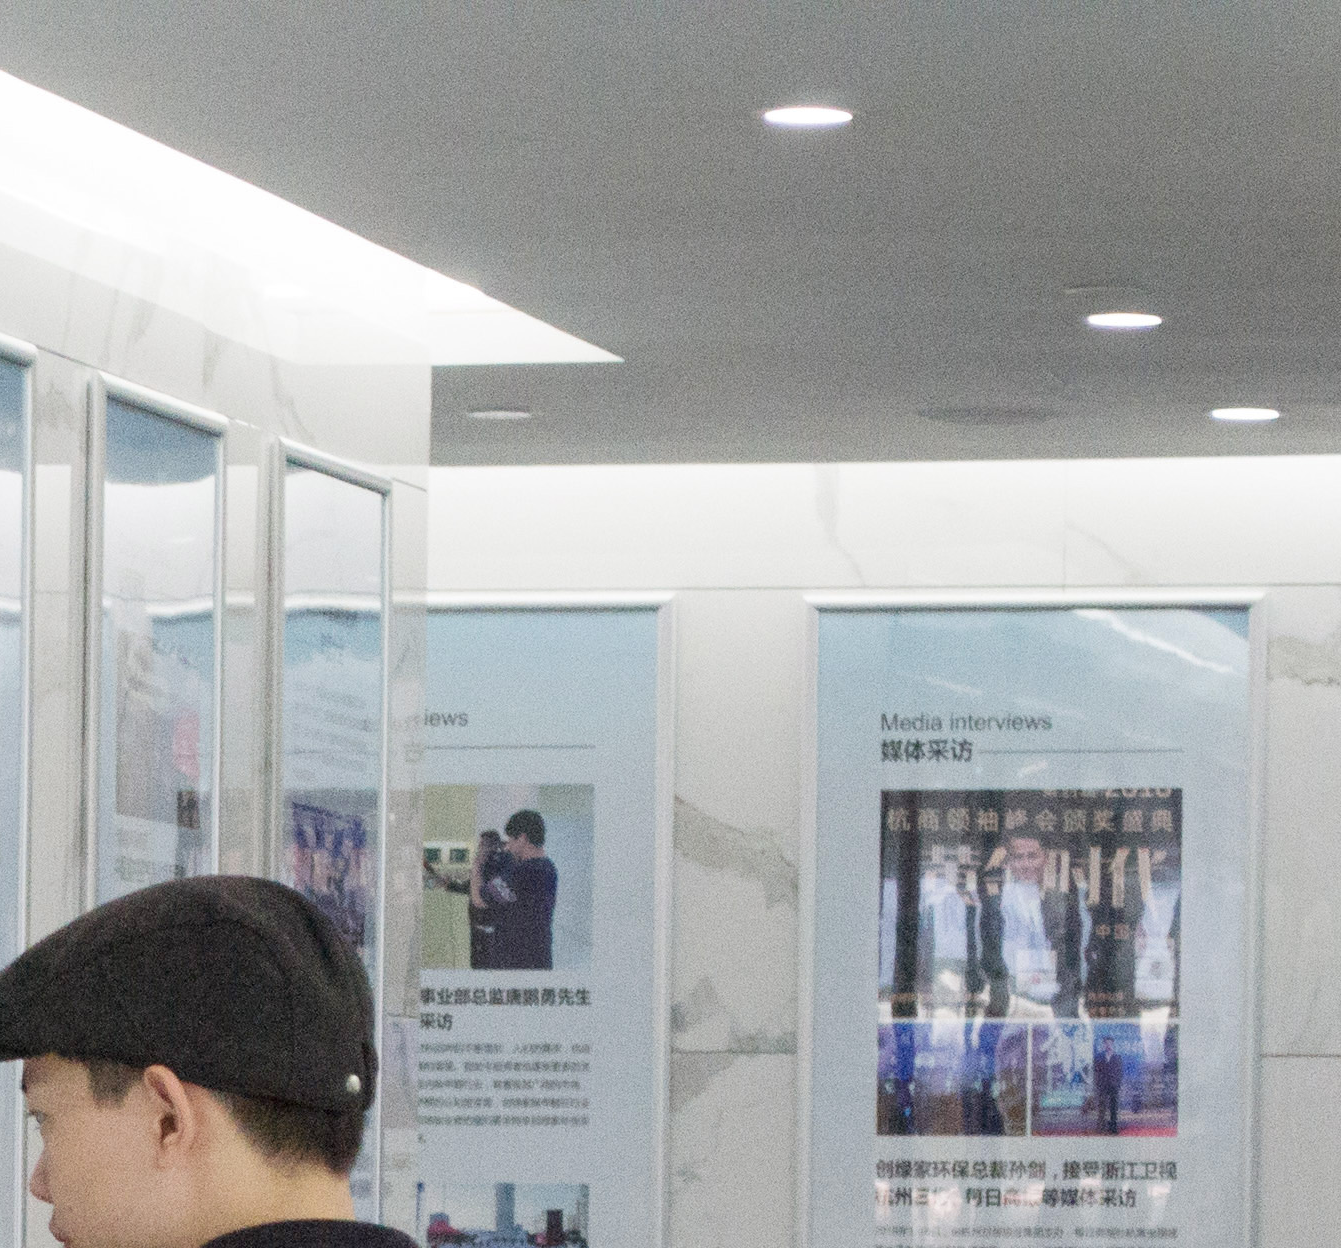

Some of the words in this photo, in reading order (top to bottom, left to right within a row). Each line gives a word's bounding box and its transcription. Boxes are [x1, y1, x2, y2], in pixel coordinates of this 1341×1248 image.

[880, 713, 943, 732] Media
[949, 712, 1053, 732] interviews
[880, 739, 973, 764] 媒体采访
[419, 1009, 454, 1032] 采访
